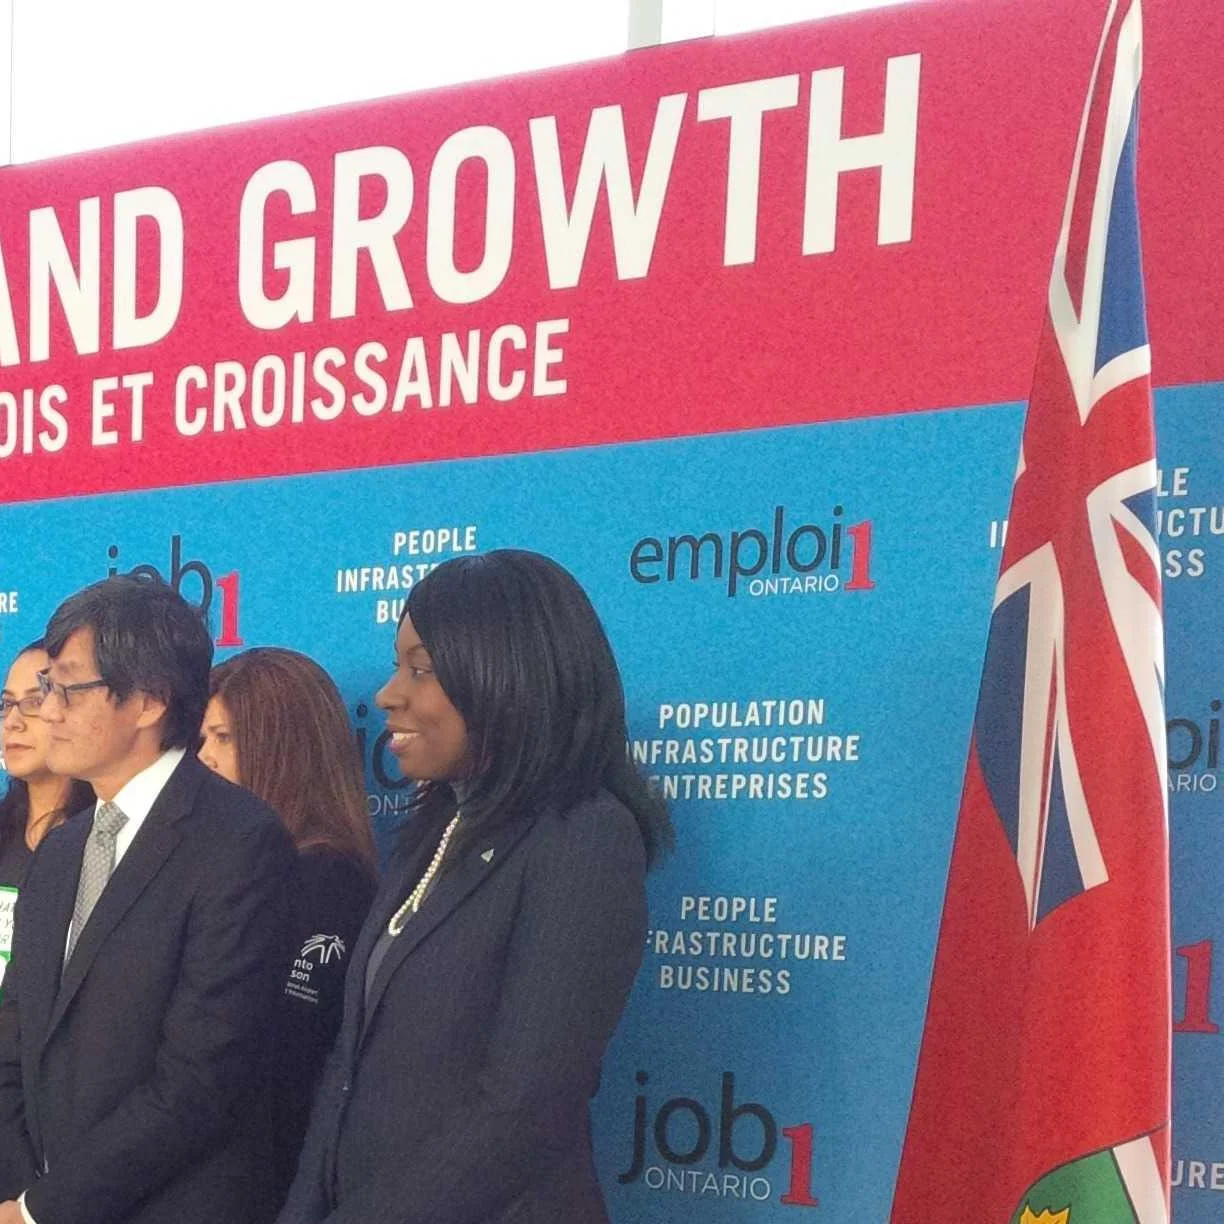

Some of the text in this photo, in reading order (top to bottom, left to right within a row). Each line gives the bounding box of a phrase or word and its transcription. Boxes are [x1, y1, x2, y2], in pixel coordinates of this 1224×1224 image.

[238, 53, 922, 330] GROWTH
[91, 372, 154, 446] ET
[176, 319, 570, 436] CROISSANCE
[394, 526, 477, 555] PEOPLE
[749, 574, 840, 597] ONTARIO
[659, 698, 825, 728] POPULATION
[680, 896, 777, 924] PEOPLE
[647, 930, 847, 961] RASTRUCTURE
[659, 965, 792, 995] BUSINESS
[644, 1166, 771, 1200] ONTARIO
